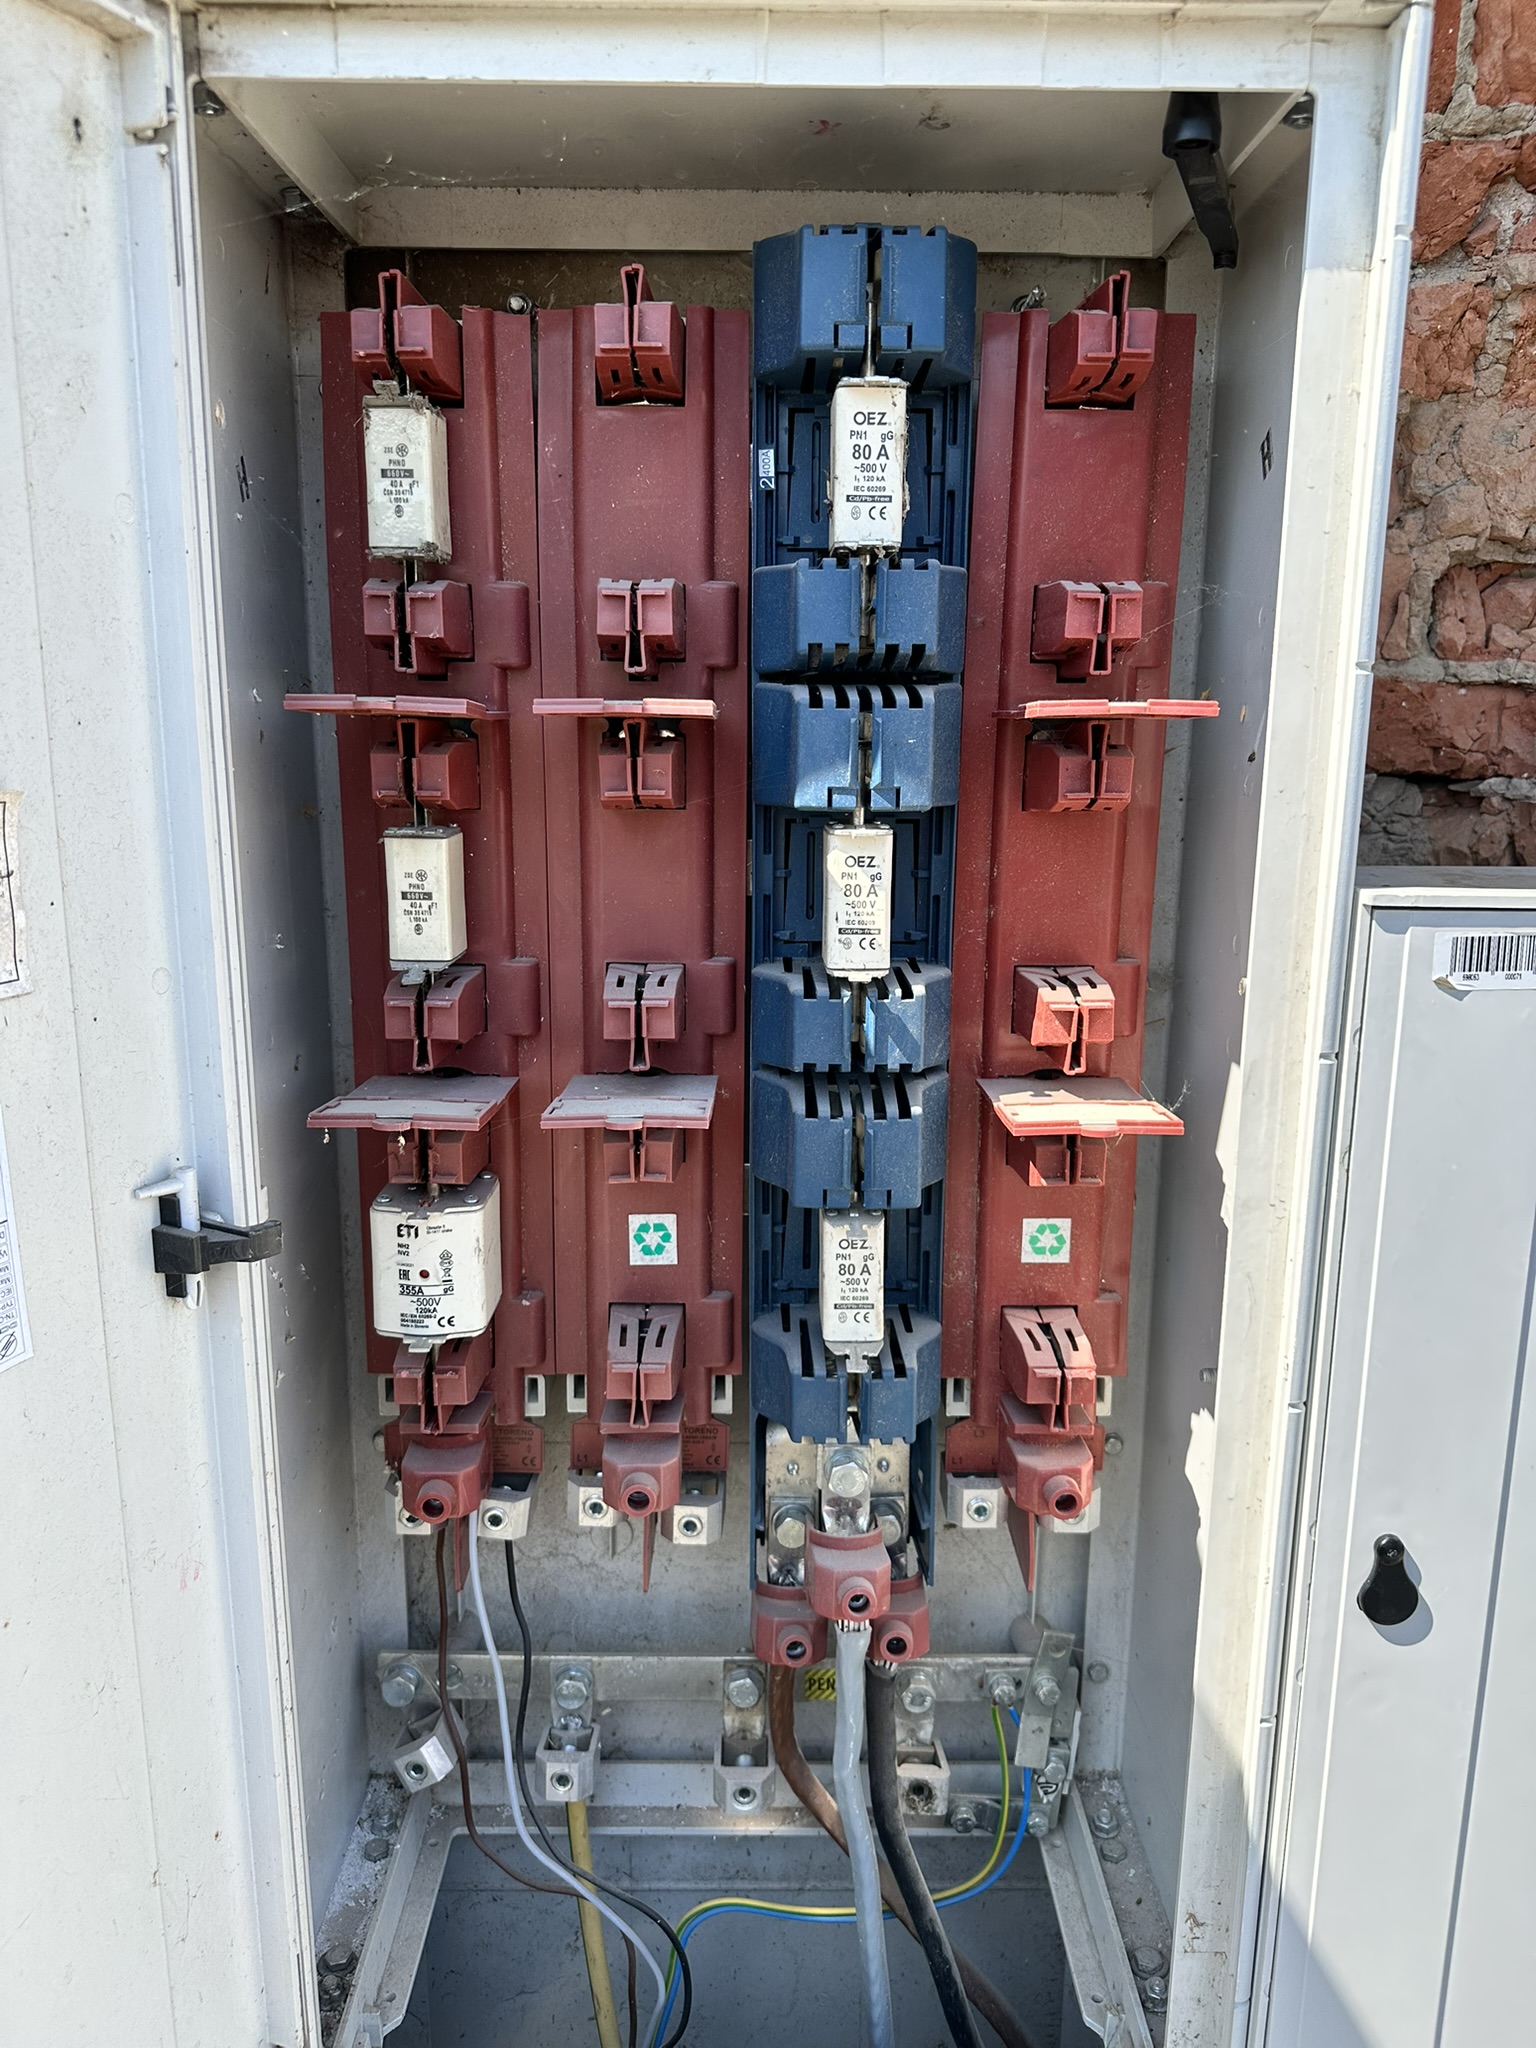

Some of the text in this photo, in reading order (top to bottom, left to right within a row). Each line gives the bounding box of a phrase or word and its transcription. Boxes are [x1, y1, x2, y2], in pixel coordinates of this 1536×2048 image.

[853, 411, 888, 426] OEZ
[850, 430, 894, 443] PN1 gG
[852, 443, 890, 460] 80 A
[759, 451, 775, 489] 2 400A
[854, 463, 887, 473] ~500 V
[390, 480, 404, 488] 40 A
[868, 505, 887, 521] CE
[844, 855, 876, 868] OEZ
[841, 872, 882, 883] PN1 gG
[843, 884, 878, 898] 80 A
[845, 900, 876, 909] ~500 V
[859, 937, 876, 950] CE
[396, 1223, 419, 1239] ETI
[397, 1242, 410, 1250] NH2
[838, 1238, 869, 1250] OEZ
[397, 1249, 410, 1257] NV2
[835, 1252, 875, 1262] PN1 gG
[838, 1263, 872, 1276] 80 A
[840, 1277, 870, 1286] ~500 V
[399, 1285, 455, 1295] 355A gG
[410, 1297, 442, 1307] ~500V
[437, 1315, 456, 1328] CE
[853, 1311, 871, 1324] CE
[499, 1428, 534, 1436] TORENO
[683, 1427, 719, 1435] TORENO
[577, 1453, 588, 1462] L1
[951, 1456, 962, 1465] L1
[808, 1677, 836, 1691] PEN
